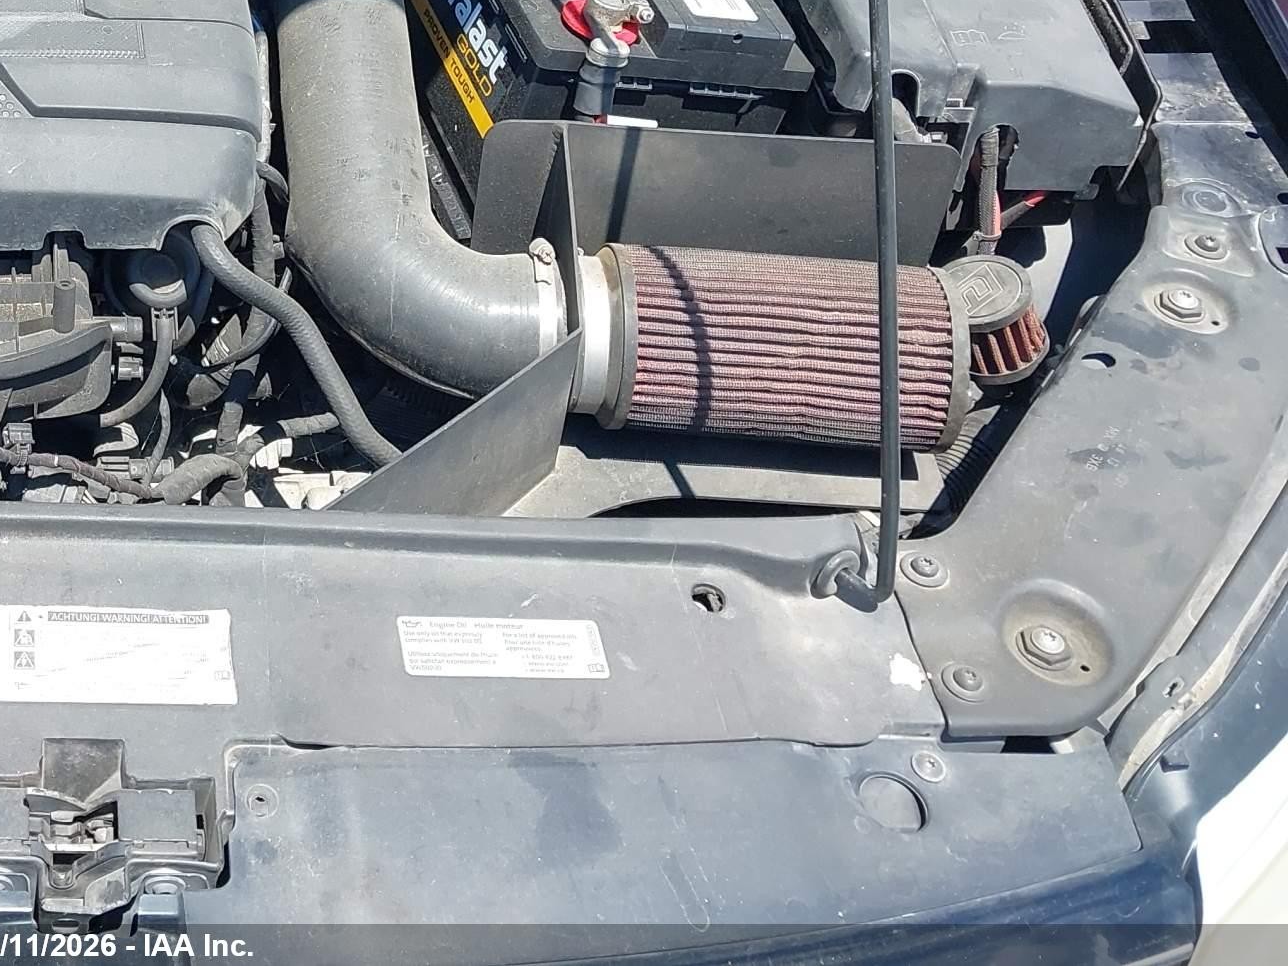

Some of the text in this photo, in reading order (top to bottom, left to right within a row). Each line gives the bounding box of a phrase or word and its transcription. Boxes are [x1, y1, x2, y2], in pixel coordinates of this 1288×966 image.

[423, 8, 475, 103] PROVEN TOUGH
[456, 34, 494, 97] GOLD
[50, 611, 99, 622] ACHTUNG!
[101, 613, 151, 623] WARNING!
